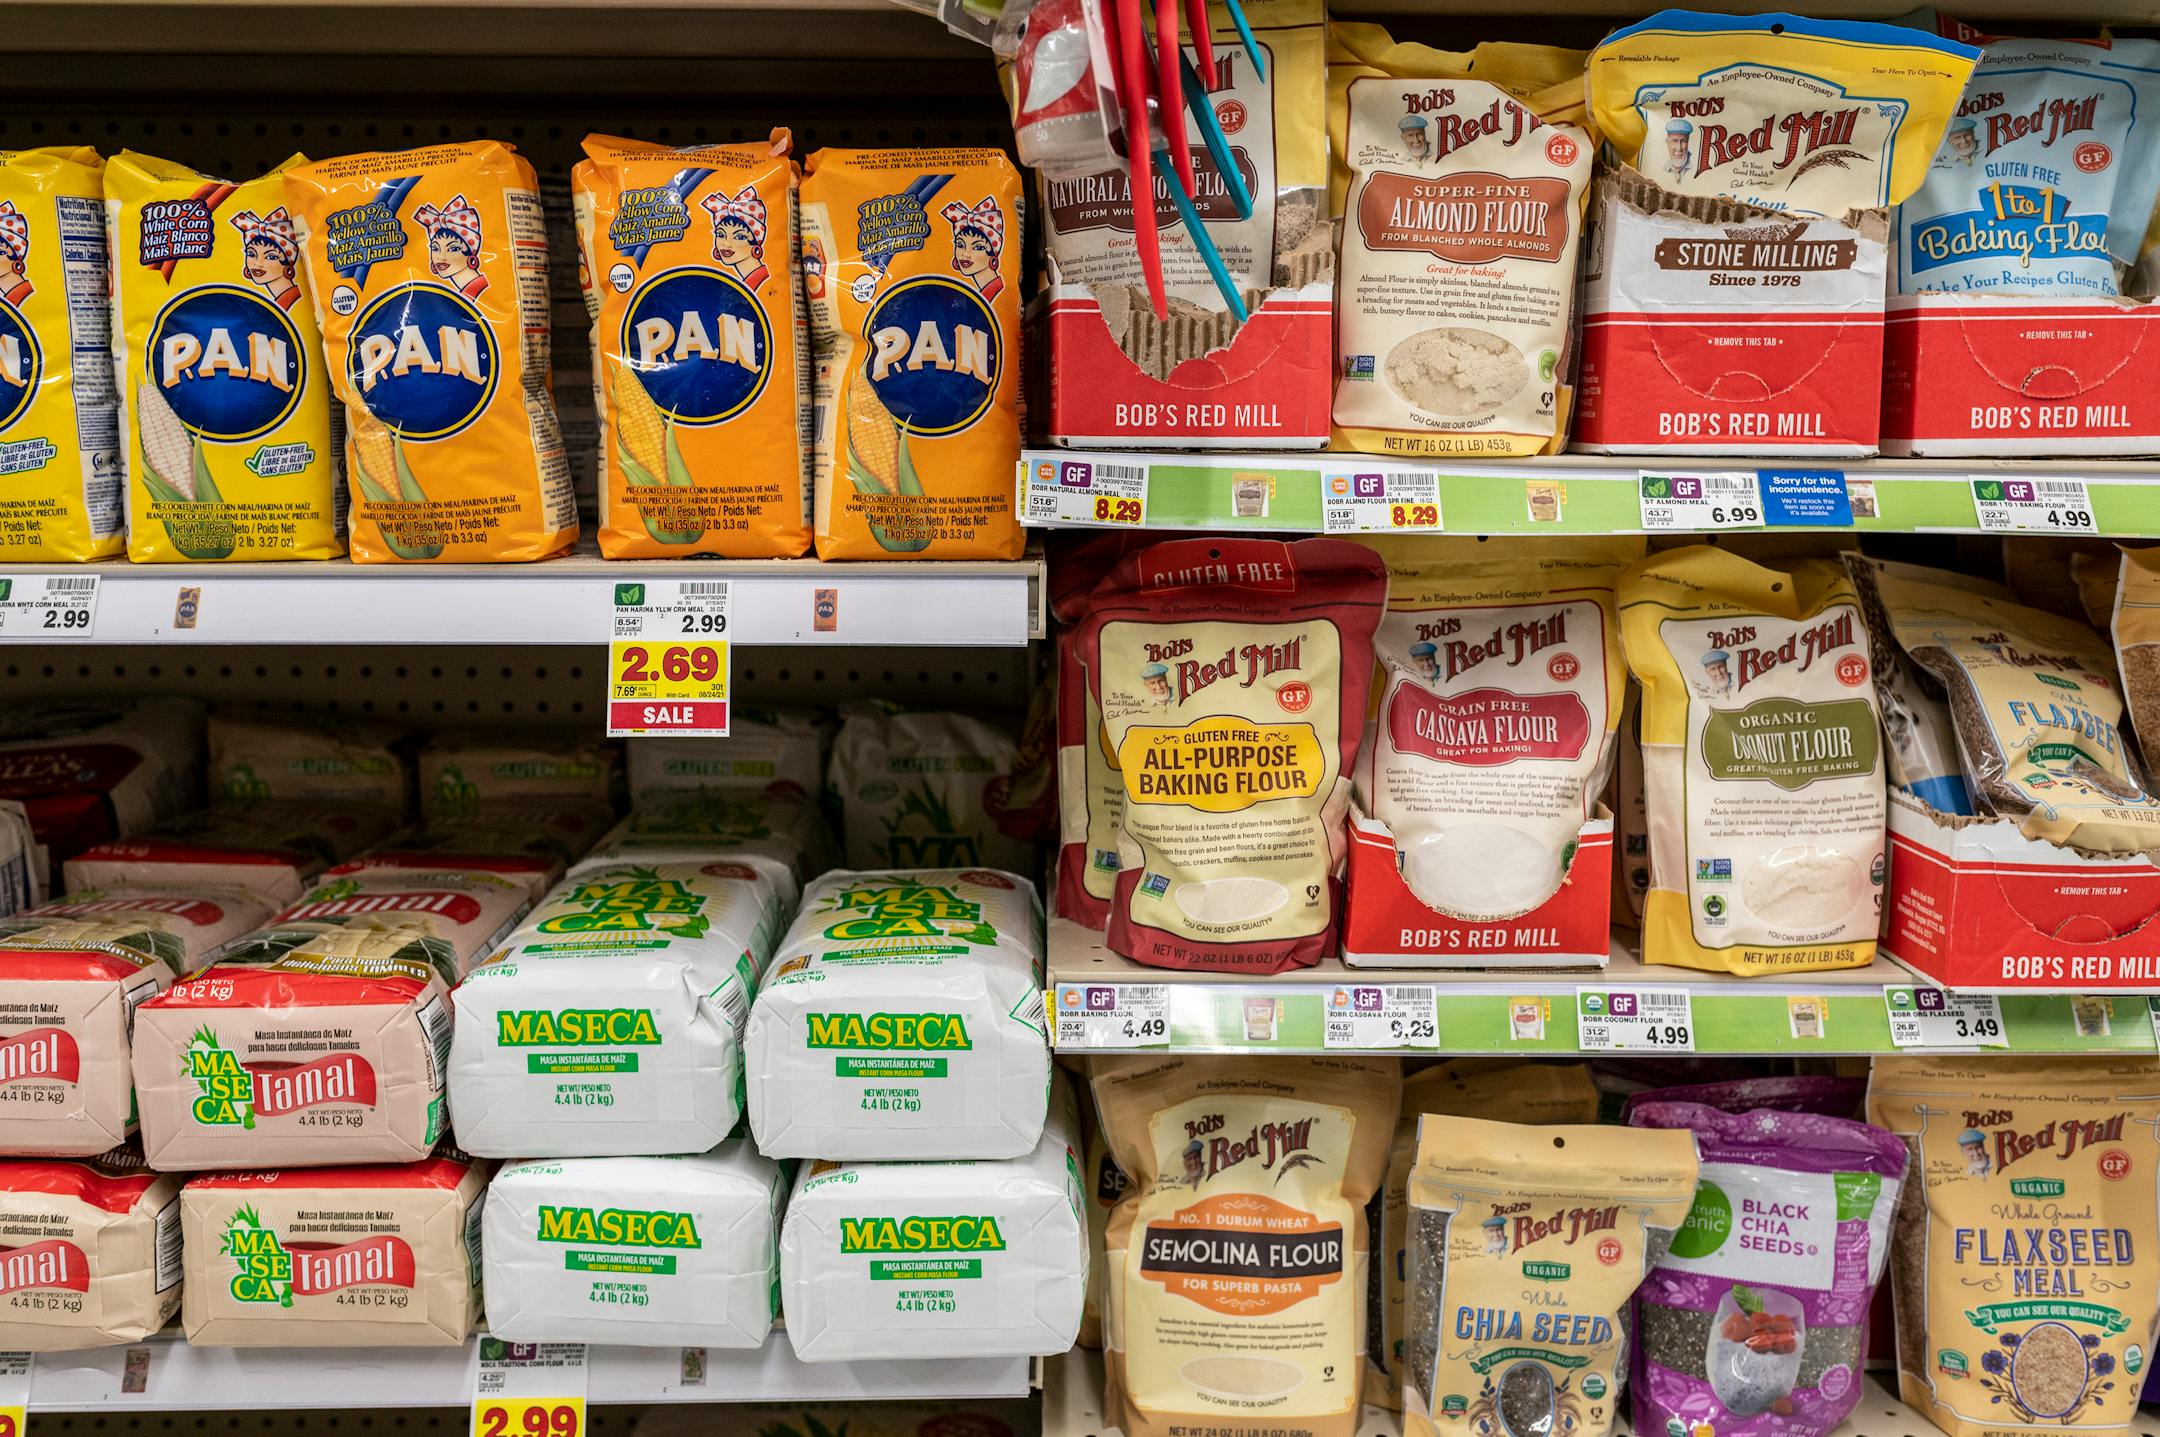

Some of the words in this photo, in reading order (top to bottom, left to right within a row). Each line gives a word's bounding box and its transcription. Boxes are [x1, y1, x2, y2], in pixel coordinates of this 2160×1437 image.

[1707, 78, 1720, 87] An
[1721, 70, 1795, 85] Employee-Owned
[1797, 79, 1835, 97] Company
[1036, 131, 1048, 142] 50
[1436, 99, 1501, 163] Red
[1551, 146, 1574, 156] GF
[1694, 114, 1776, 179] Red
[1773, 107, 1861, 169] Mill
[1985, 163, 2028, 178] GLUTEN
[2032, 165, 2061, 186] FREE
[1051, 177, 1117, 210] NATURAL
[1414, 186, 1530, 198] SUPER-FINE
[2004, 187, 2041, 216] to
[144, 203, 206, 220] 100%
[330, 205, 390, 230] 100%
[1390, 197, 1477, 232] ALMOND
[1483, 202, 1549, 236] FLOUR
[144, 219, 175, 234] White
[179, 218, 208, 229] Corn
[331, 227, 366, 242] Yellow
[369, 220, 396, 233] Corn
[144, 233, 168, 247] Maíz
[171, 231, 208, 242] Blanco
[1381, 233, 1408, 241] FROM
[1412, 234, 1465, 246] BLANCHED
[1468, 238, 1503, 247] WHOLE
[1506, 240, 1550, 252] ALMONDS
[1918, 219, 2034, 268] Baking
[143, 246, 169, 260] Maïs
[173, 244, 207, 255] Blanc
[1678, 243, 1745, 266] STONE
[1752, 244, 1839, 267] MILLING
[1427, 264, 1454, 274] Great
[1455, 266, 1468, 275] for
[1471, 267, 1506, 278] baking!
[1709, 274, 1756, 286] Since
[1761, 275, 1801, 286] 1978
[1963, 273, 1998, 289] Your
[2002, 270, 2053, 288] Recipes
[2057, 271, 2099, 289] Gluten
[1714, 338, 1743, 346] REMOVE
[1745, 338, 1762, 346] THIS
[1763, 338, 1777, 346] TAB
[1116, 404, 1178, 427] BOB'S
[1186, 404, 1226, 427] RED
[1235, 404, 1282, 427] MILL
[264, 445, 305, 458] GLUTEN-FREE
[1384, 436, 1403, 450] NET
[1405, 437, 1421, 450] WT
[1424, 438, 1437, 452] 16
[1439, 439, 1452, 451] OZ
[1487, 439, 1511, 451] 453g
[261, 456, 280, 466] LIBRE
[288, 453, 313, 463] GLUTEN
[260, 466, 277, 476] SANS
[279, 463, 303, 473] GLUTEN
[1066, 467, 1086, 482] GF
[1769, 485, 1843, 494] inconvenience.
[1773, 476, 1800, 487] Sorry
[1802, 476, 1817, 485] for
[1818, 477, 1836, 485] the
[1049, 486, 1076, 494] NATURAL
[1078, 489, 1103, 497] ALMOND
[193, 503, 215, 511] WHITE
[216, 503, 236, 511] CORN
[1096, 499, 1141, 521] 8.29
[1393, 506, 1437, 526] 8.29
[1712, 507, 1758, 522] 6.99
[2048, 511, 2091, 527] 4.99
[43, 610, 90, 629] 2.99
[681, 614, 727, 633] 2.99
[621, 646, 719, 682] 2.69
[1176, 647, 1239, 707] Red
[1240, 636, 1302, 688] Mill
[643, 707, 694, 724] SALE
[1439, 701, 1486, 716] GRAIN
[1490, 701, 1531, 712] FREE
[1416, 708, 1489, 746] CASSAVA
[1494, 716, 1559, 744] FLOUR
[1739, 711, 1817, 728] ORGANIC
[1184, 731, 1230, 744] GLUTEN
[1232, 730, 1259, 742] FREE
[1790, 726, 1853, 761] FLOUR
[1144, 745, 1298, 770] ALL-PURPOSE
[1436, 747, 1467, 756] GREAT
[1469, 746, 1489, 754] FOR
[1140, 773, 1228, 796] BAKING
[1236, 770, 1307, 794] FLOUR
[1192, 857, 1222, 866] crackers,
[1224, 855, 1248, 864] muffins,
[1249, 854, 1272, 862] cookies
[1400, 929, 1461, 948] BOB'S
[1468, 930, 1507, 947] RED
[1514, 928, 1560, 947] MILL
[255, 1030, 275, 1040] Masa
[500, 1012, 658, 1043] MASECA
[811, 1017, 968, 1047] MASECA
[1122, 1019, 1165, 1038] 4.49
[1646, 1026, 1689, 1046] 4.99
[1956, 1019, 1999, 1037] 3.49
[540, 1055, 557, 1064] MASA
[258, 1058, 355, 1112] Tamal
[555, 1095, 571, 1105] 4.4
[573, 1094, 582, 1105] lb
[1695, 1204, 1725, 1217] truth
[1742, 1199, 1809, 1220] BLACK
[542, 1210, 698, 1245] MASECA
[1216, 1215, 1263, 1227] DURUM
[1266, 1217, 1310, 1228] WHEAT
[1741, 1217, 1790, 1236] CHIA
[1148, 1239, 1261, 1266] SEMOLINA
[1269, 1241, 1339, 1268] FLOUR
[1740, 1236, 1804, 1256] SEEDS
[1954, 1228, 2134, 1266] FLAXSEED
[1183, 1279, 1208, 1289] FOR
[1212, 1281, 1259, 1293] SUPERB
[1264, 1282, 1302, 1293] PASTA
[2013, 1269, 2084, 1297] MEAL
[1456, 1306, 1523, 1341] CHIA
[1533, 1313, 1613, 1345] SEED
